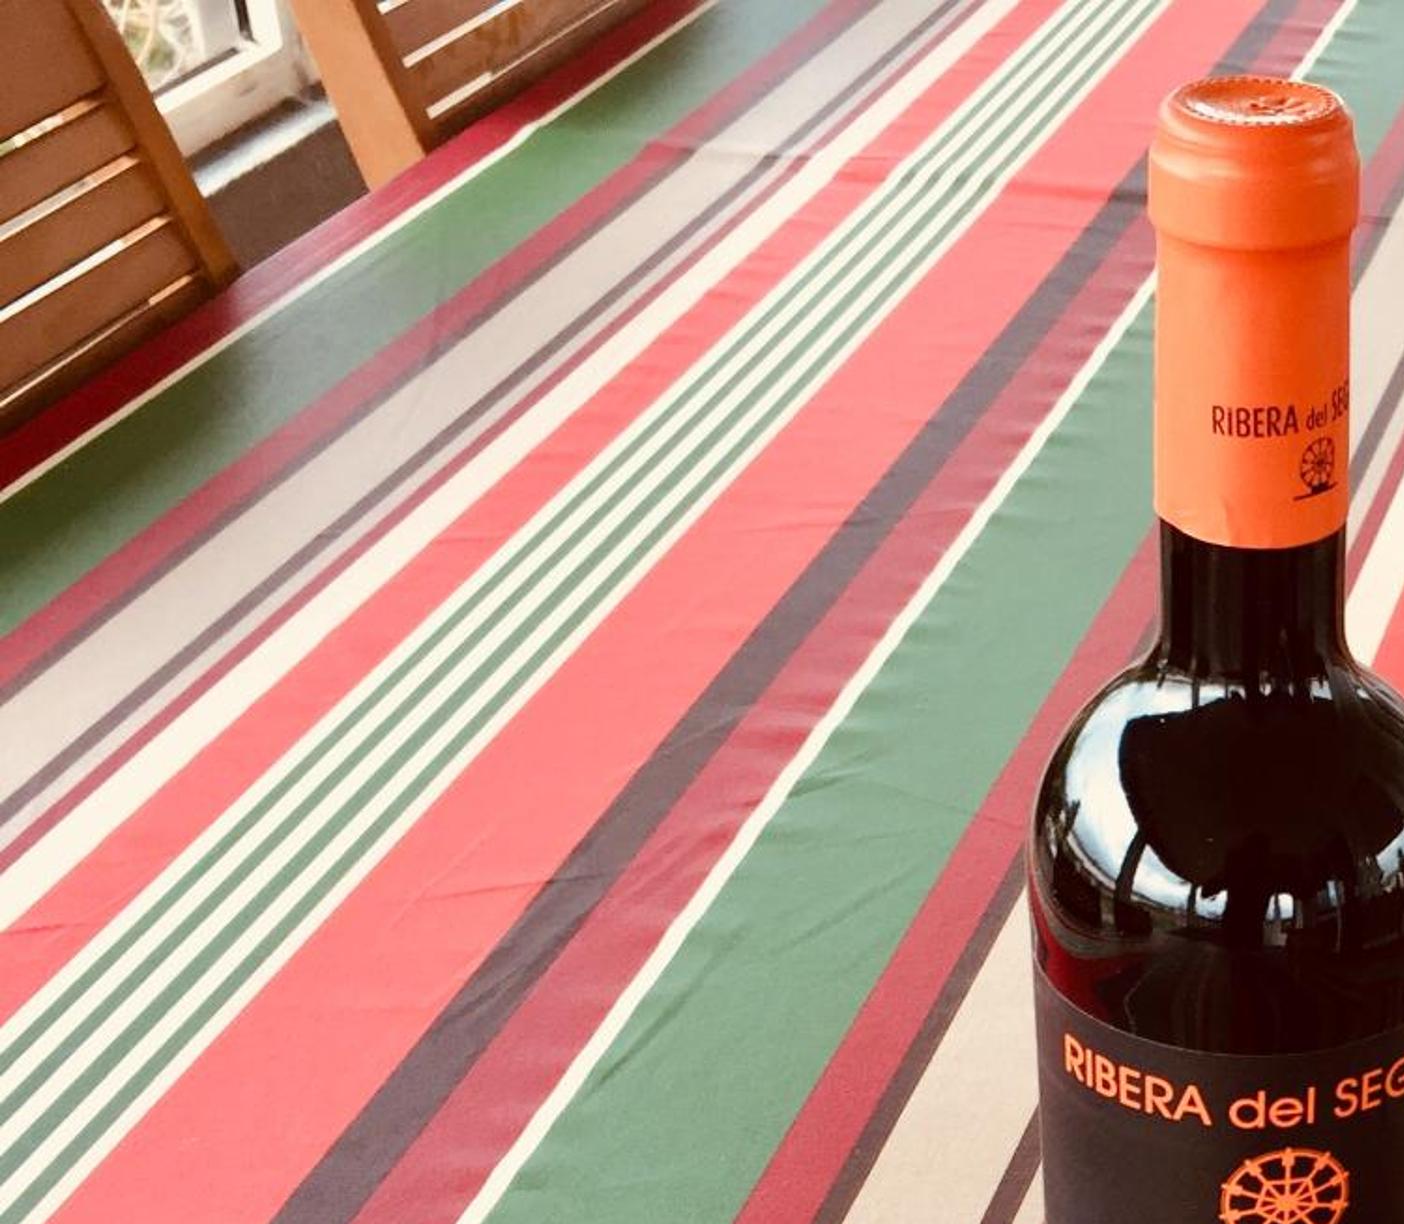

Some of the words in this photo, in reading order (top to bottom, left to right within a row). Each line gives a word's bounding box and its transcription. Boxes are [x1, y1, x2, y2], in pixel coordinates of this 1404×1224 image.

[1212, 404, 1299, 438] RIBERA
[1306, 404, 1328, 431] del
[1063, 1032, 1213, 1127] RIBERA
[1228, 1086, 1316, 1130] del
